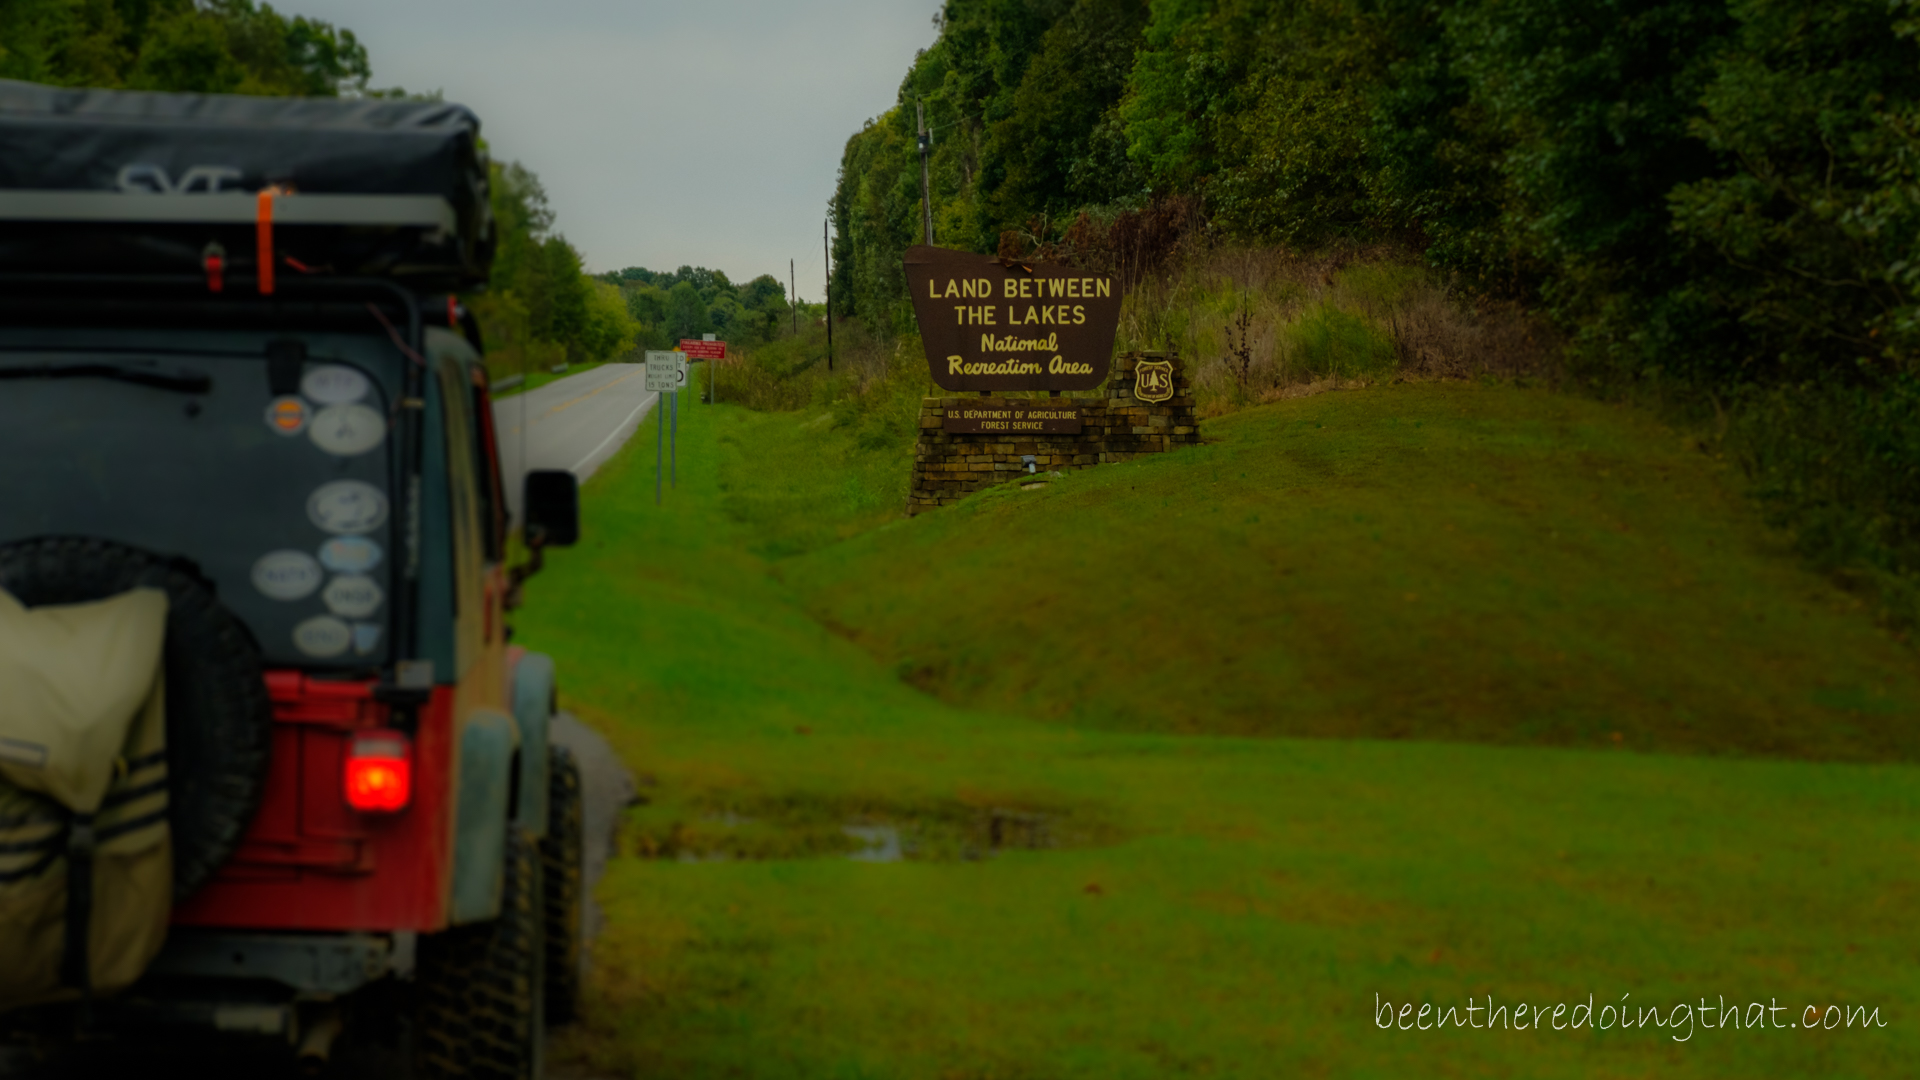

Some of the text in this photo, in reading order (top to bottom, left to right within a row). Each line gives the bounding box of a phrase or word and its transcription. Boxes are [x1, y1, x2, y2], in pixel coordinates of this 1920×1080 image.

[929, 277, 1111, 299] LAND BETWEEN
[954, 304, 1086, 326] THE LAKES
[981, 332, 1059, 352] National
[946, 354, 1094, 375] Recreation Area
[947, 410, 1077, 420] U.S. DEPARTMENT OF AGRICULTURE
[981, 421, 1044, 430] FOREST SERVICE
